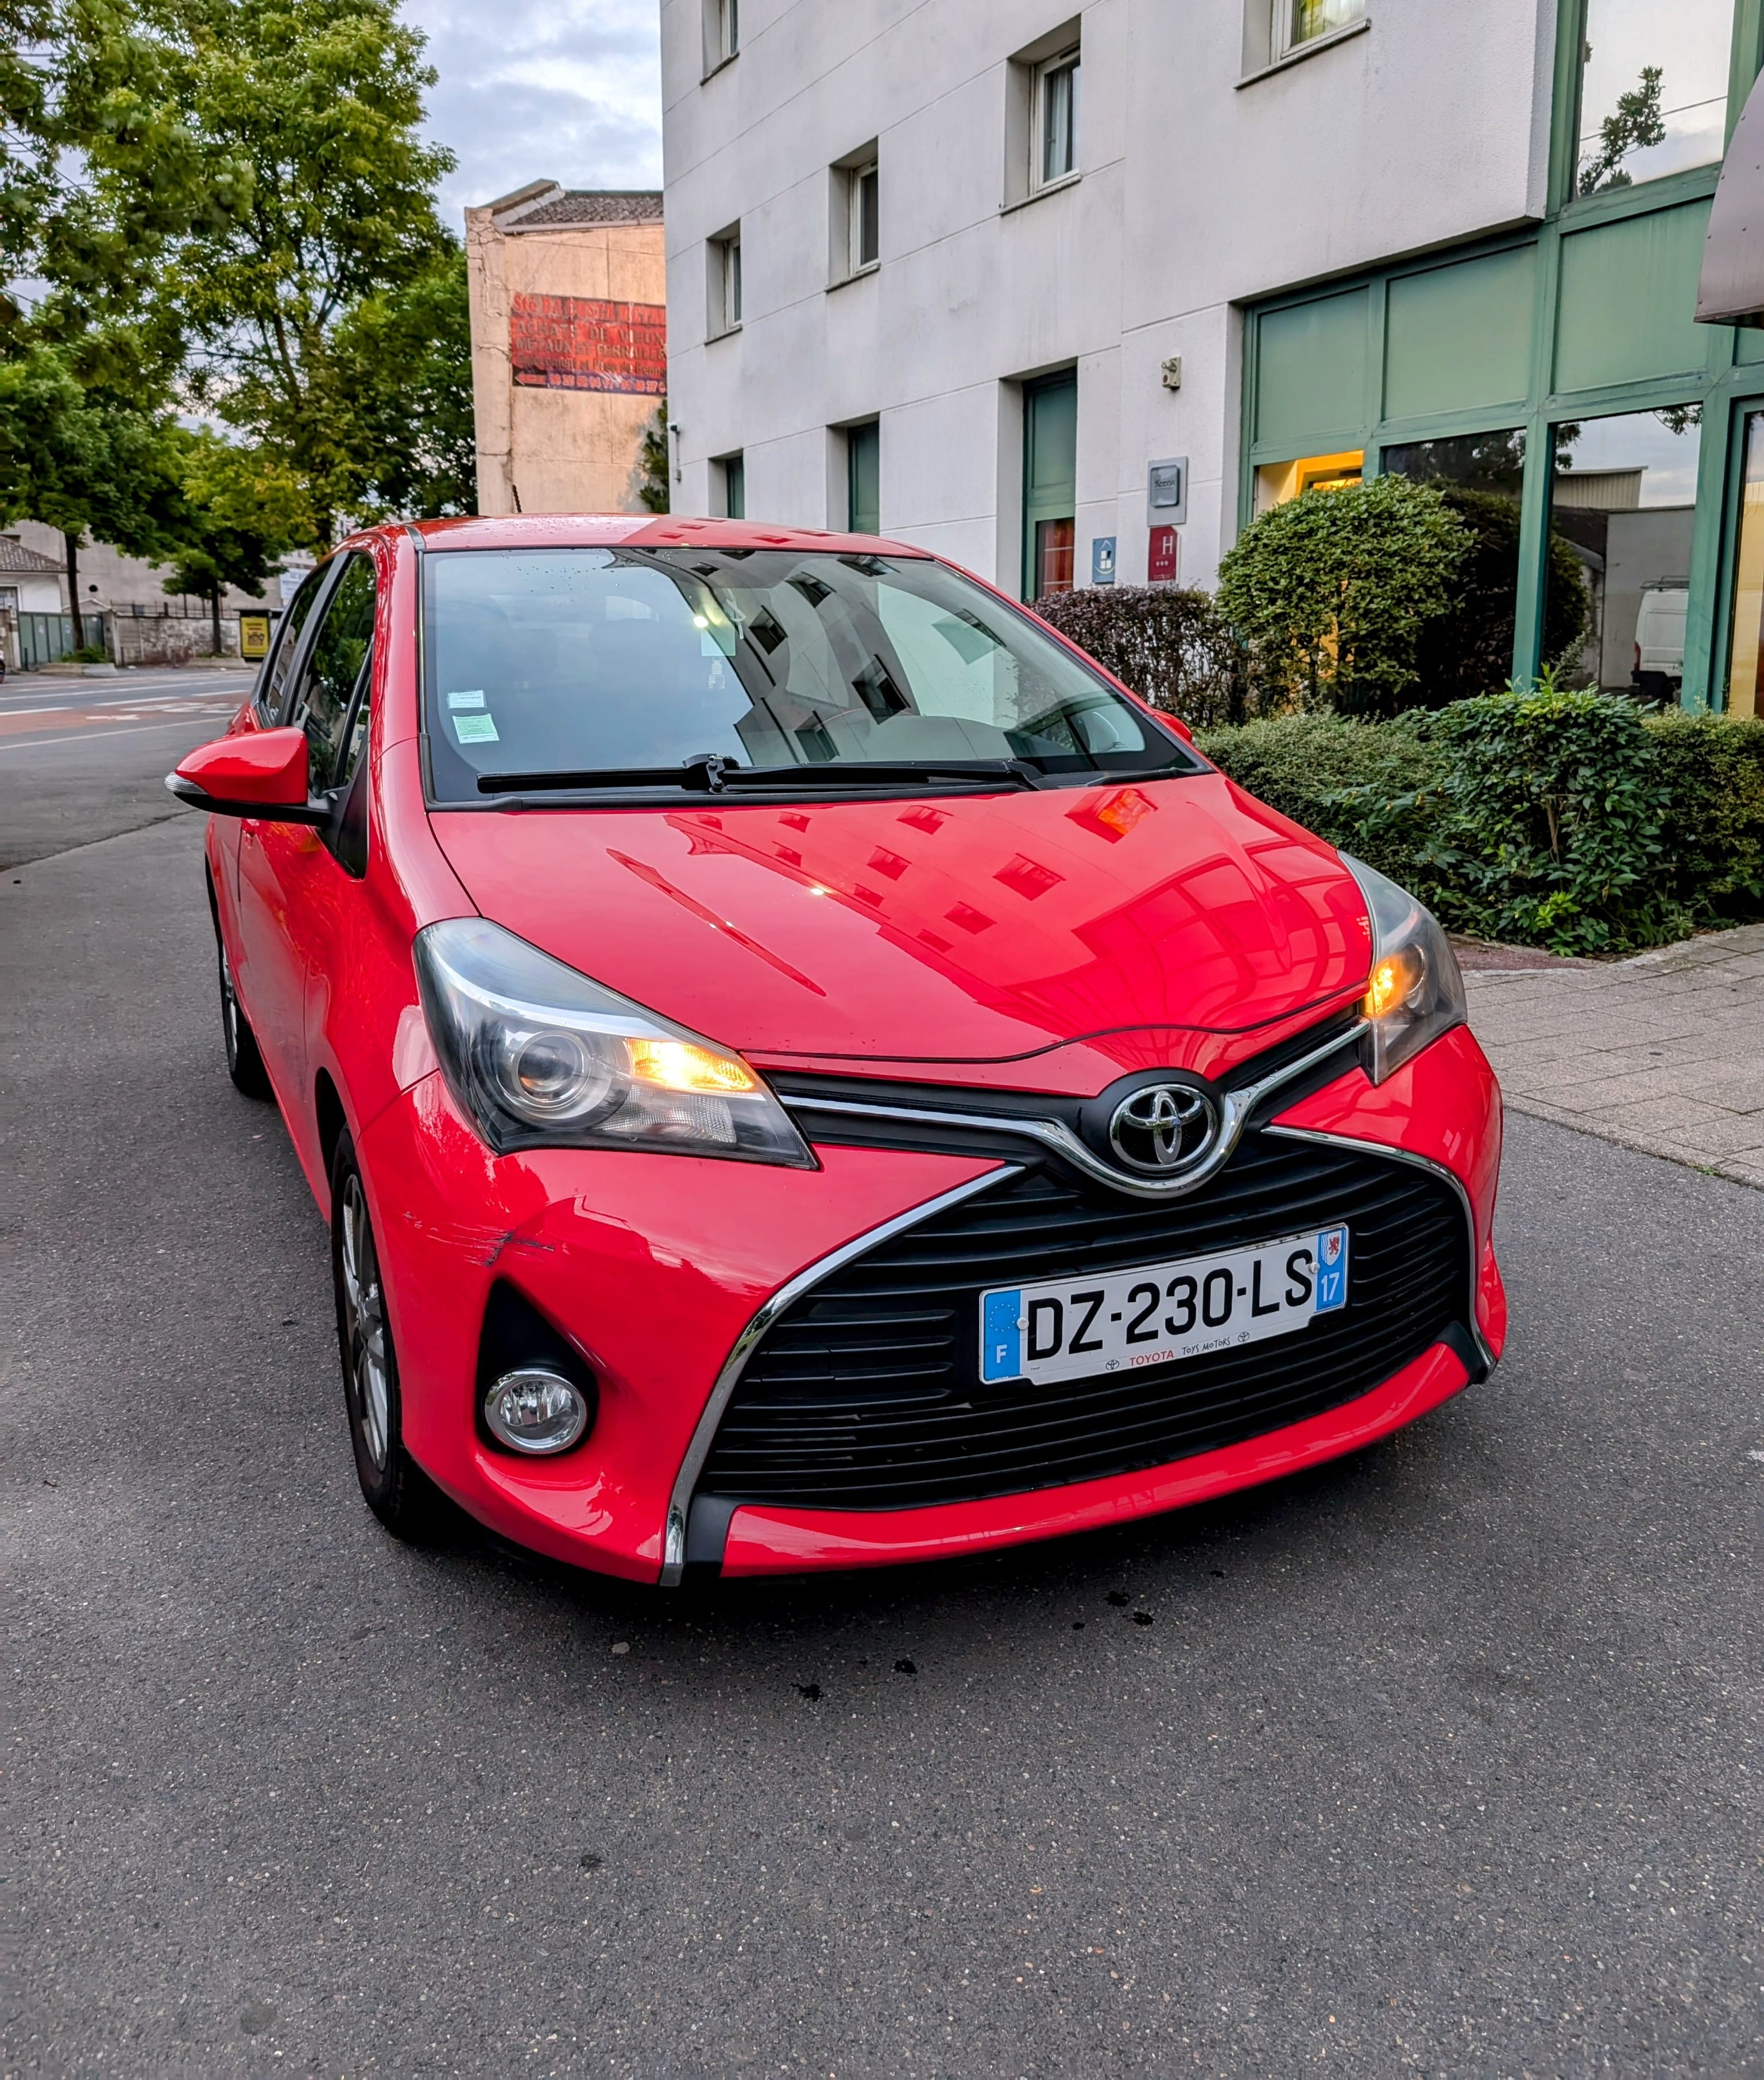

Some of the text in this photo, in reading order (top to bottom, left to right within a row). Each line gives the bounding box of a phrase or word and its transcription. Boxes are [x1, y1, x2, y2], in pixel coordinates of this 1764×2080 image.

[517, 321, 666, 345] ACHATS DE VIEUX
[577, 342, 591, 354] ET
[1162, 536, 1174, 555] H
[1321, 1272, 1340, 1302] 17
[1027, 1249, 1313, 1361] DZ-230-LS
[996, 1345, 1007, 1363] F
[1129, 1350, 1174, 1366] TOYOTA
